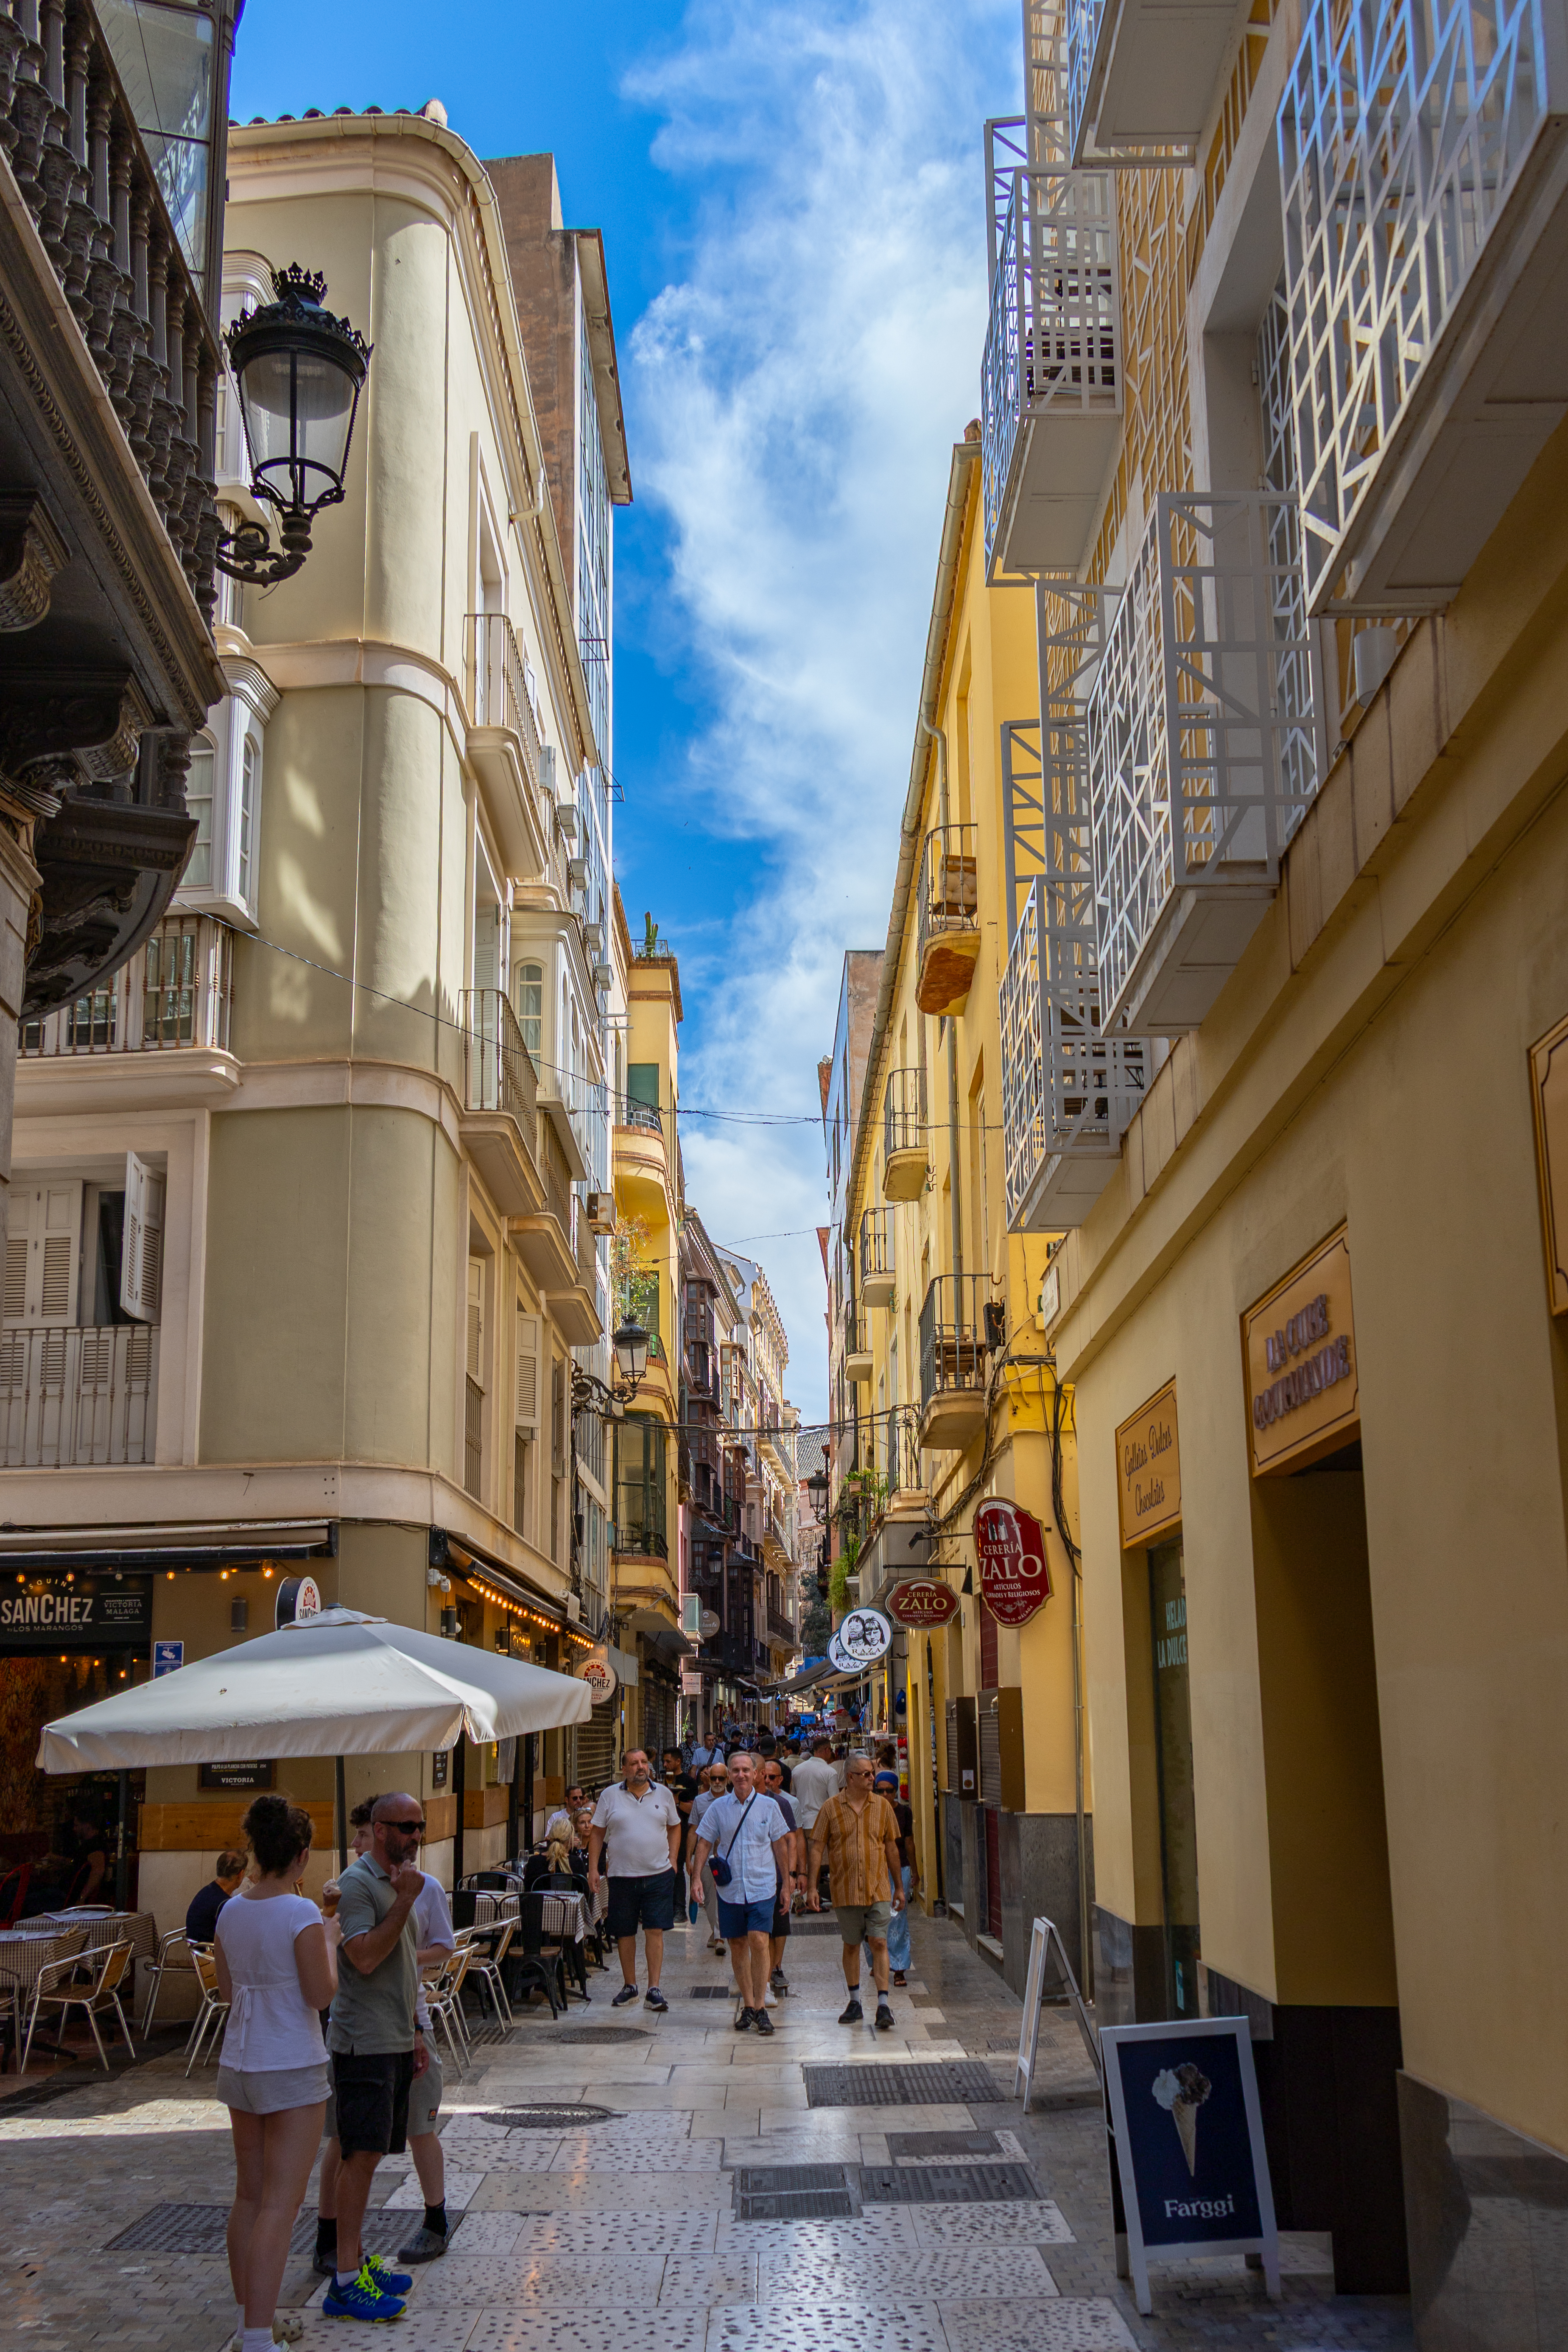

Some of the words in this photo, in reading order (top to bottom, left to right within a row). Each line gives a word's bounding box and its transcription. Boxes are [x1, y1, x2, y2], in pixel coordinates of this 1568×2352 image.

[1265, 1330, 1287, 1373] LA
[1254, 1335, 1350, 1429] GOURMANDE
[1125, 1442, 1148, 1492] Galletas
[1149, 1421, 1172, 1460] Dulces
[1135, 1478, 1165, 1516] Chocolates
[984, 1541, 1022, 1555] CERERÍA
[980, 1555, 1043, 1580] ZALO
[22, 1578, 74, 1594] ESQUINA
[1, 1594, 93, 1624] SANCHEZ
[899, 1598, 947, 1610] ZALO
[1157, 1640, 1166, 1668] LA
[1167, 1635, 1187, 1667] DULCE
[1164, 2194, 1235, 2218] Farggi
